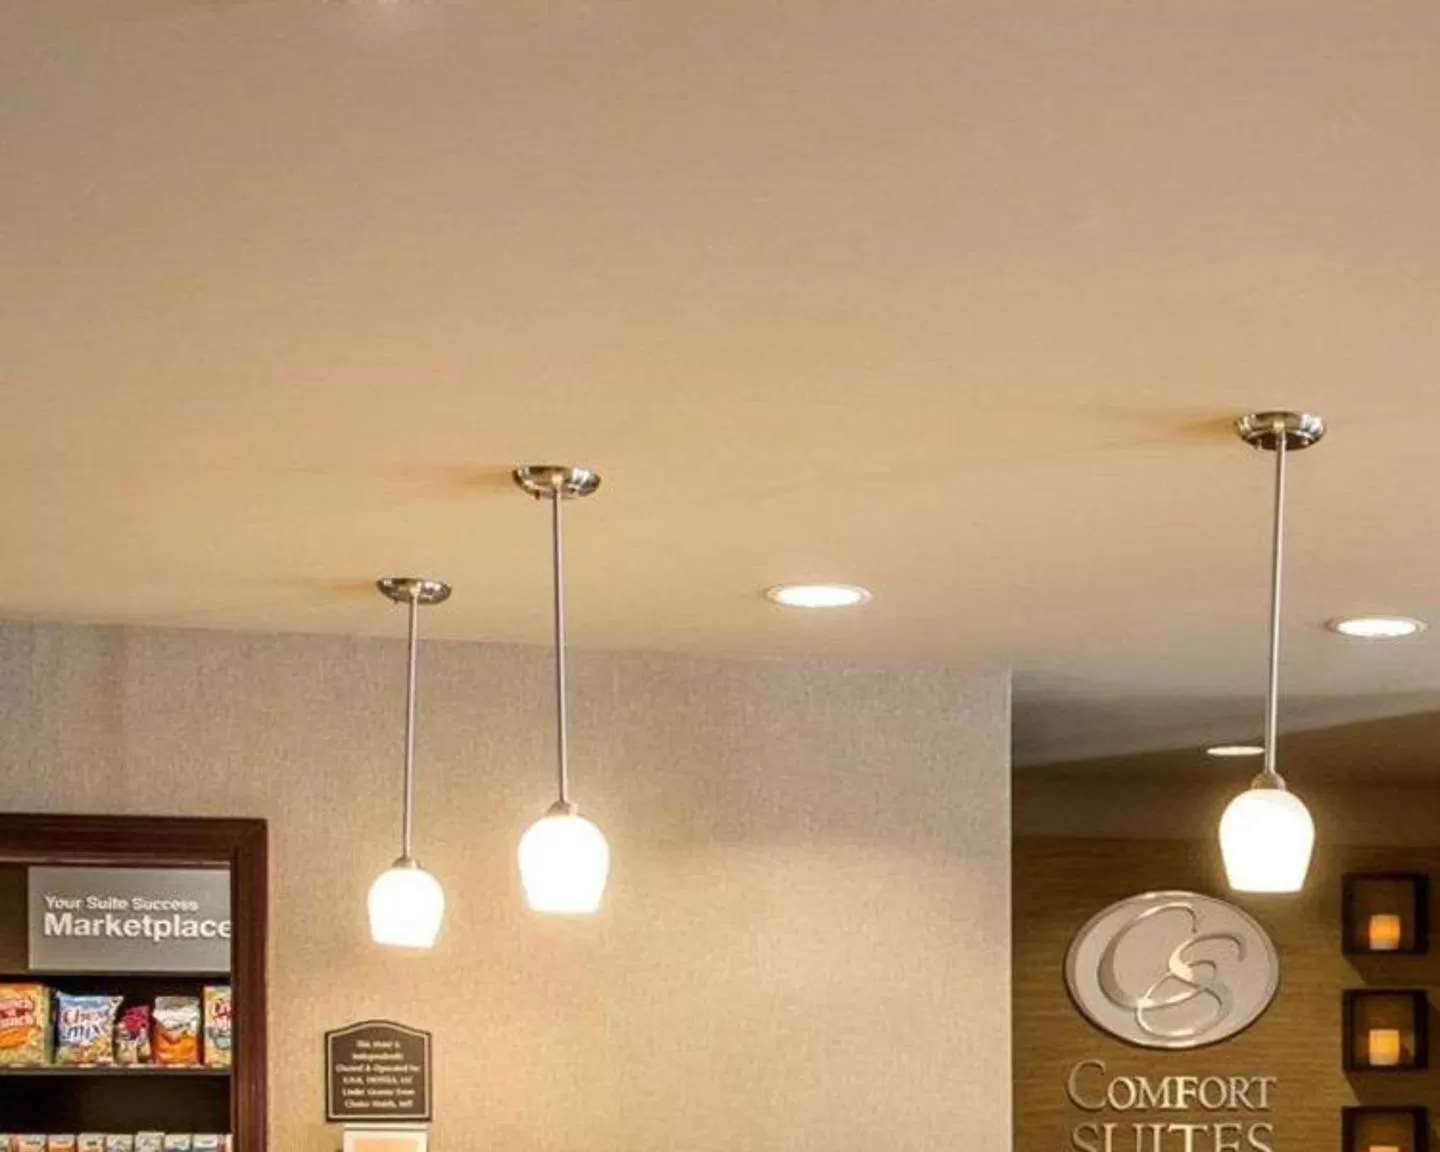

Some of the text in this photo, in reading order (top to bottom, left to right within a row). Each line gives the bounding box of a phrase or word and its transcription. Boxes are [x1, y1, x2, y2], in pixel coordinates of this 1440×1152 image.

[44, 895, 199, 912] Your Suite Success
[43, 911, 232, 943] Marketplace
